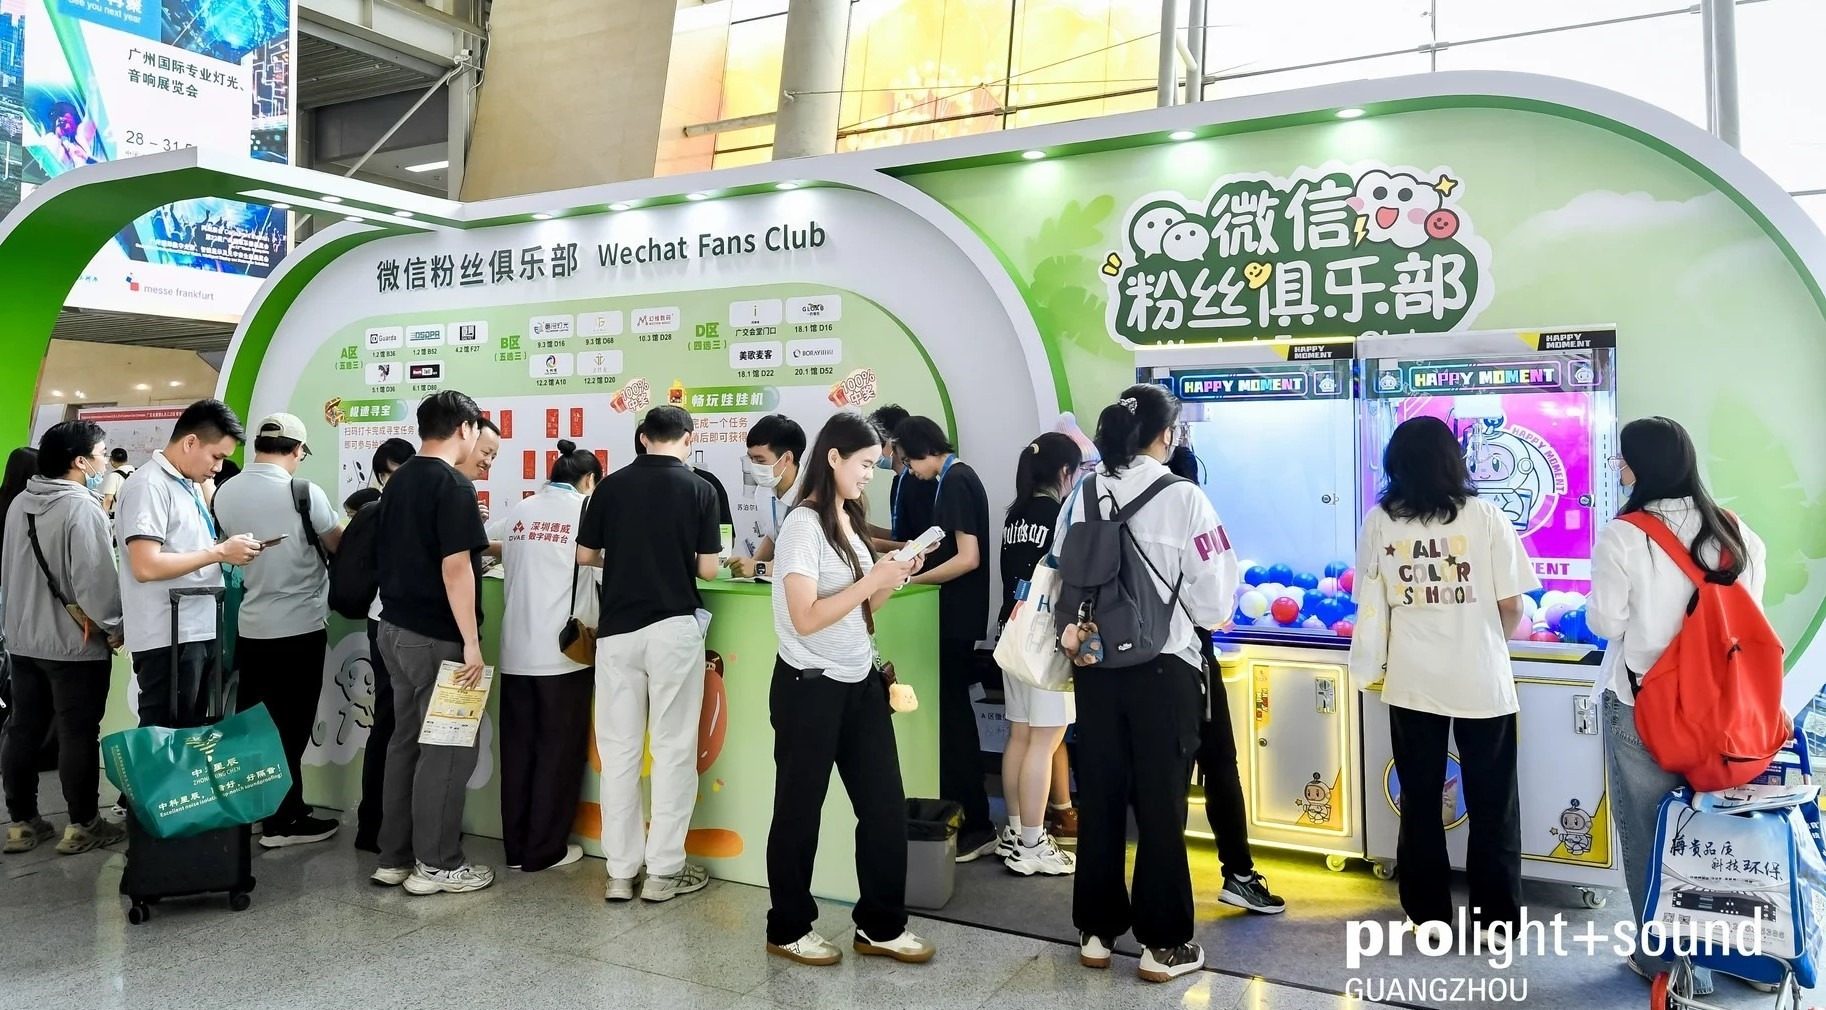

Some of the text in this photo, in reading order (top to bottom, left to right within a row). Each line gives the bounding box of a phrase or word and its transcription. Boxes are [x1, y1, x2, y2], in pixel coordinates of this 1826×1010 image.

[128, 68, 198, 98] 音响展览会
[126, 130, 144, 146] 28
[1211, 180, 1354, 258] 微信
[377, 221, 826, 292] 微信粉丝俱乐部 Wechat Fans Club
[144, 284, 214, 300] messe frankfurt
[1125, 252, 1467, 331] 粉丝俱乐部
[696, 322, 719, 338] D区
[1546, 333, 1582, 342] HAPPY
[501, 335, 520, 349] B区
[1294, 345, 1325, 353] HAPPY
[1546, 340, 1591, 349] MOMENT
[341, 346, 358, 359] A区
[842, 368, 876, 394] 100%
[1184, 378, 1302, 393] HAPPY MOMENT
[1415, 368, 1555, 387] HAPPY MOMENT
[620, 378, 649, 400] 100%
[849, 384, 875, 405] 中奖
[628, 392, 649, 411] 中奖
[691, 392, 764, 407] 畅玩娃娃机
[350, 405, 390, 417] 极速寻宝
[1512, 427, 1564, 493] HAPPY MOMENT
[530, 521, 572, 534] 深圳德威
[528, 532, 569, 544] 数字调音台
[1399, 562, 1471, 584] COLOR
[1532, 562, 1570, 576] ENT
[1402, 586, 1477, 606] SCHOOL
[192, 758, 239, 778] 中星辰
